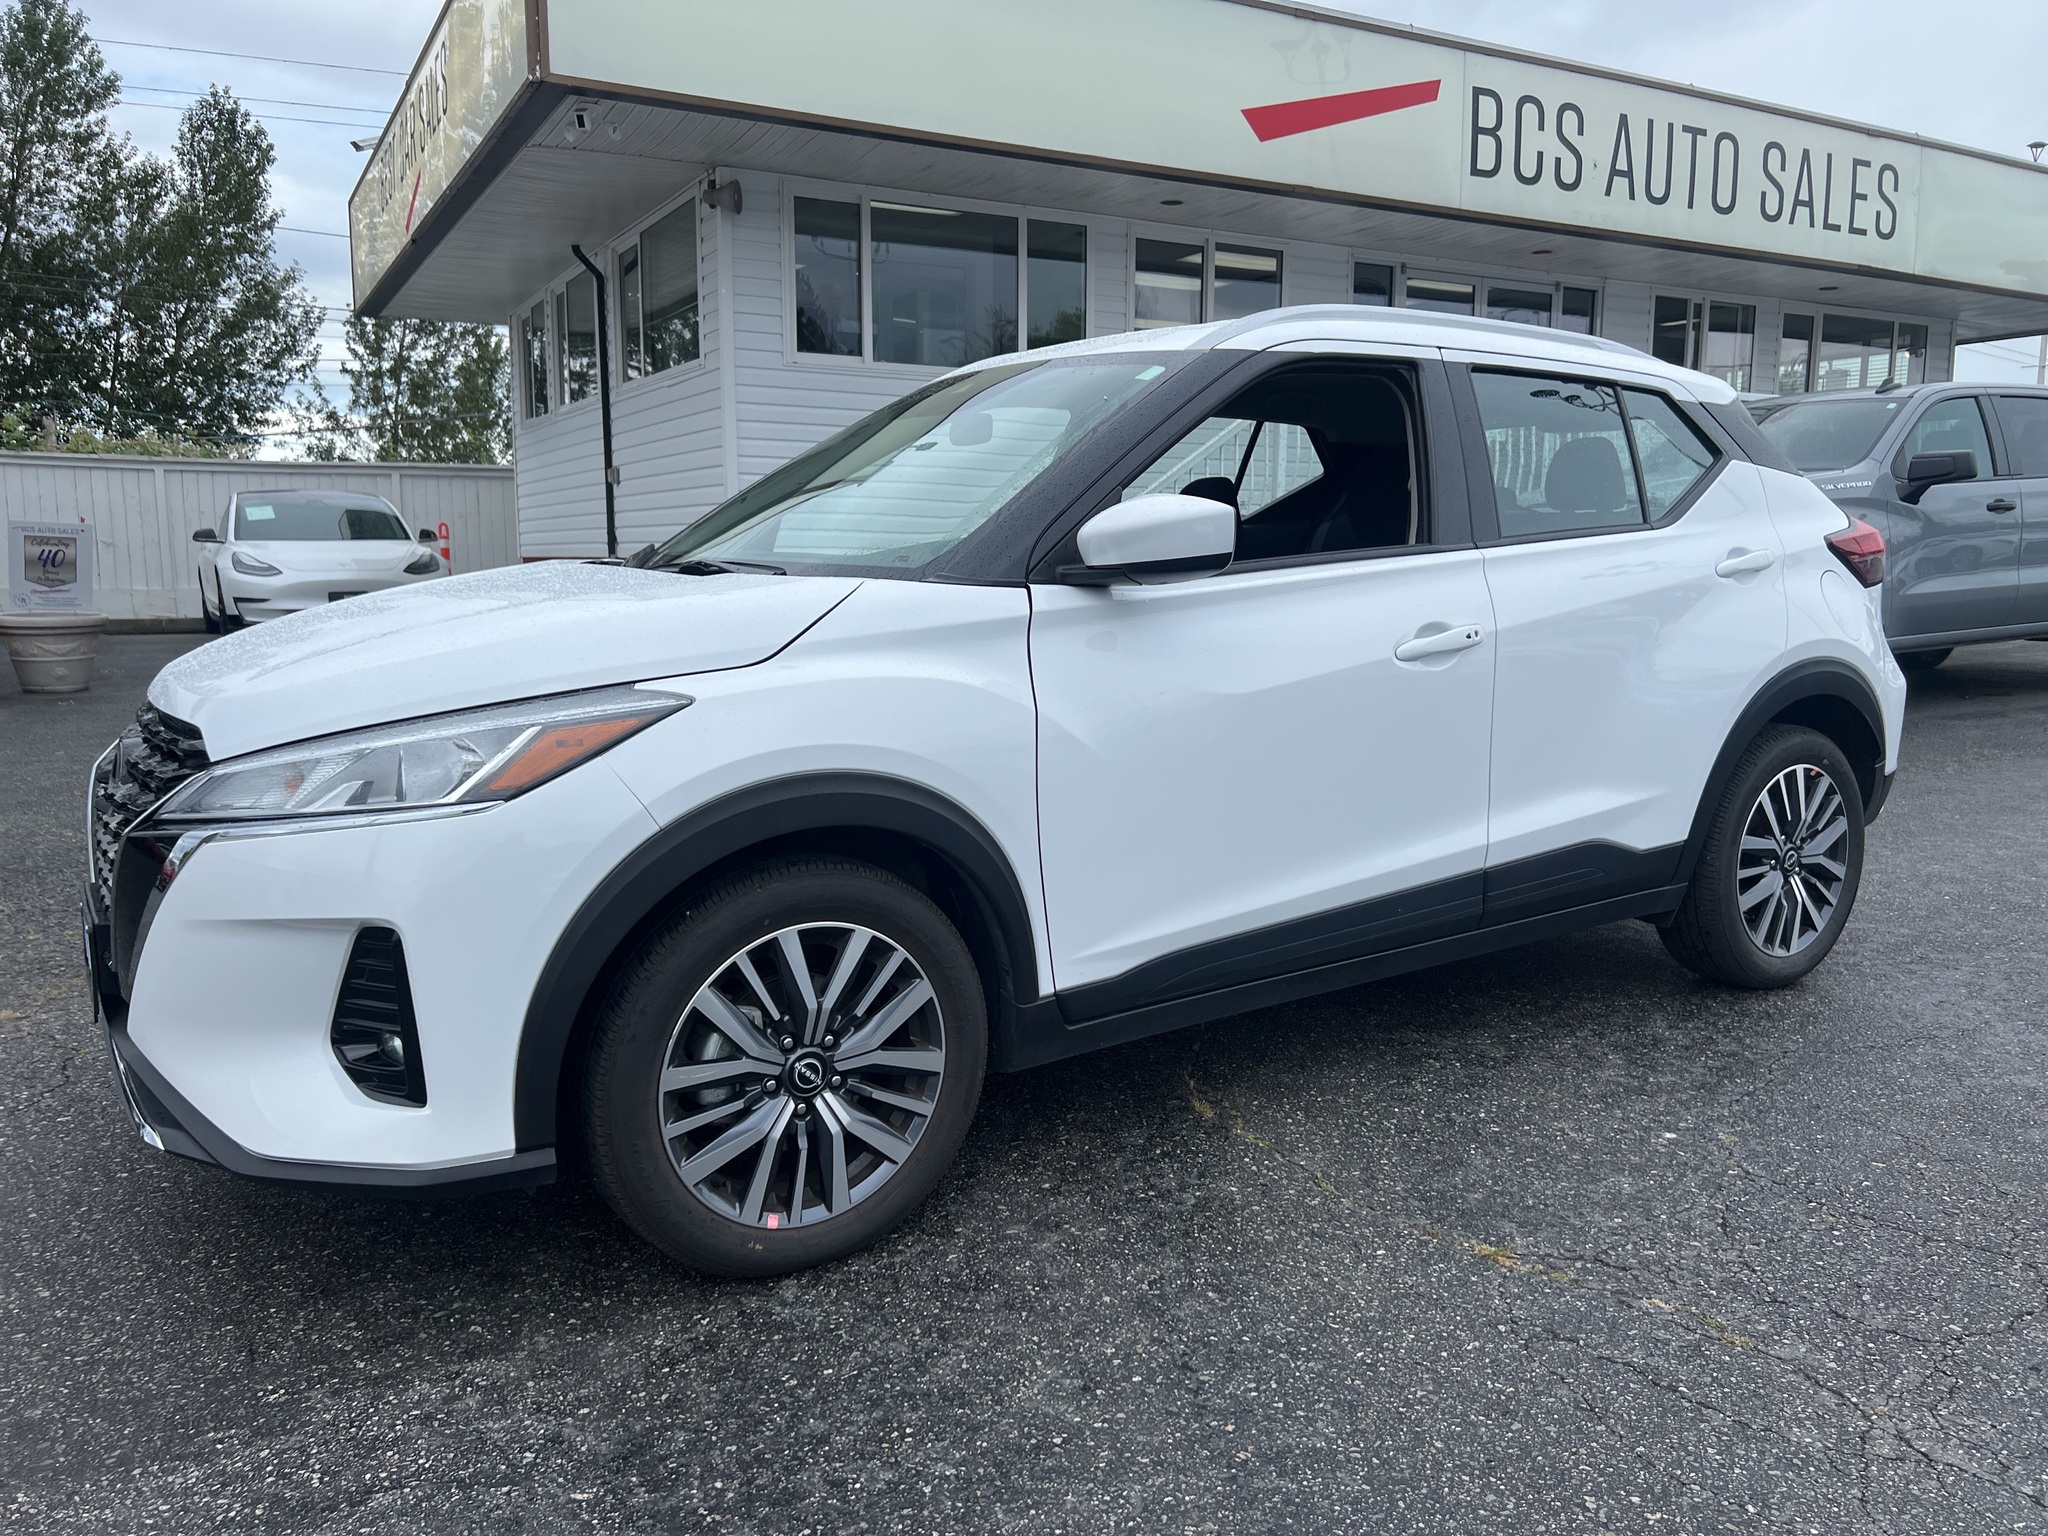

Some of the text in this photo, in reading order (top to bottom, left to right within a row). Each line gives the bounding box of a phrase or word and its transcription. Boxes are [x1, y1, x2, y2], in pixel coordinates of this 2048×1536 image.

[379, 40, 448, 214] BEST CAR SALES
[1469, 85, 1900, 241] BCS AUTO SALES
[1821, 480, 1872, 490] SILVERADO
[37, 526, 56, 534] AUTO
[57, 527, 80, 535] SALES
[37, 548, 66, 568] 40
[794, 1062, 822, 1085] NISSAN
